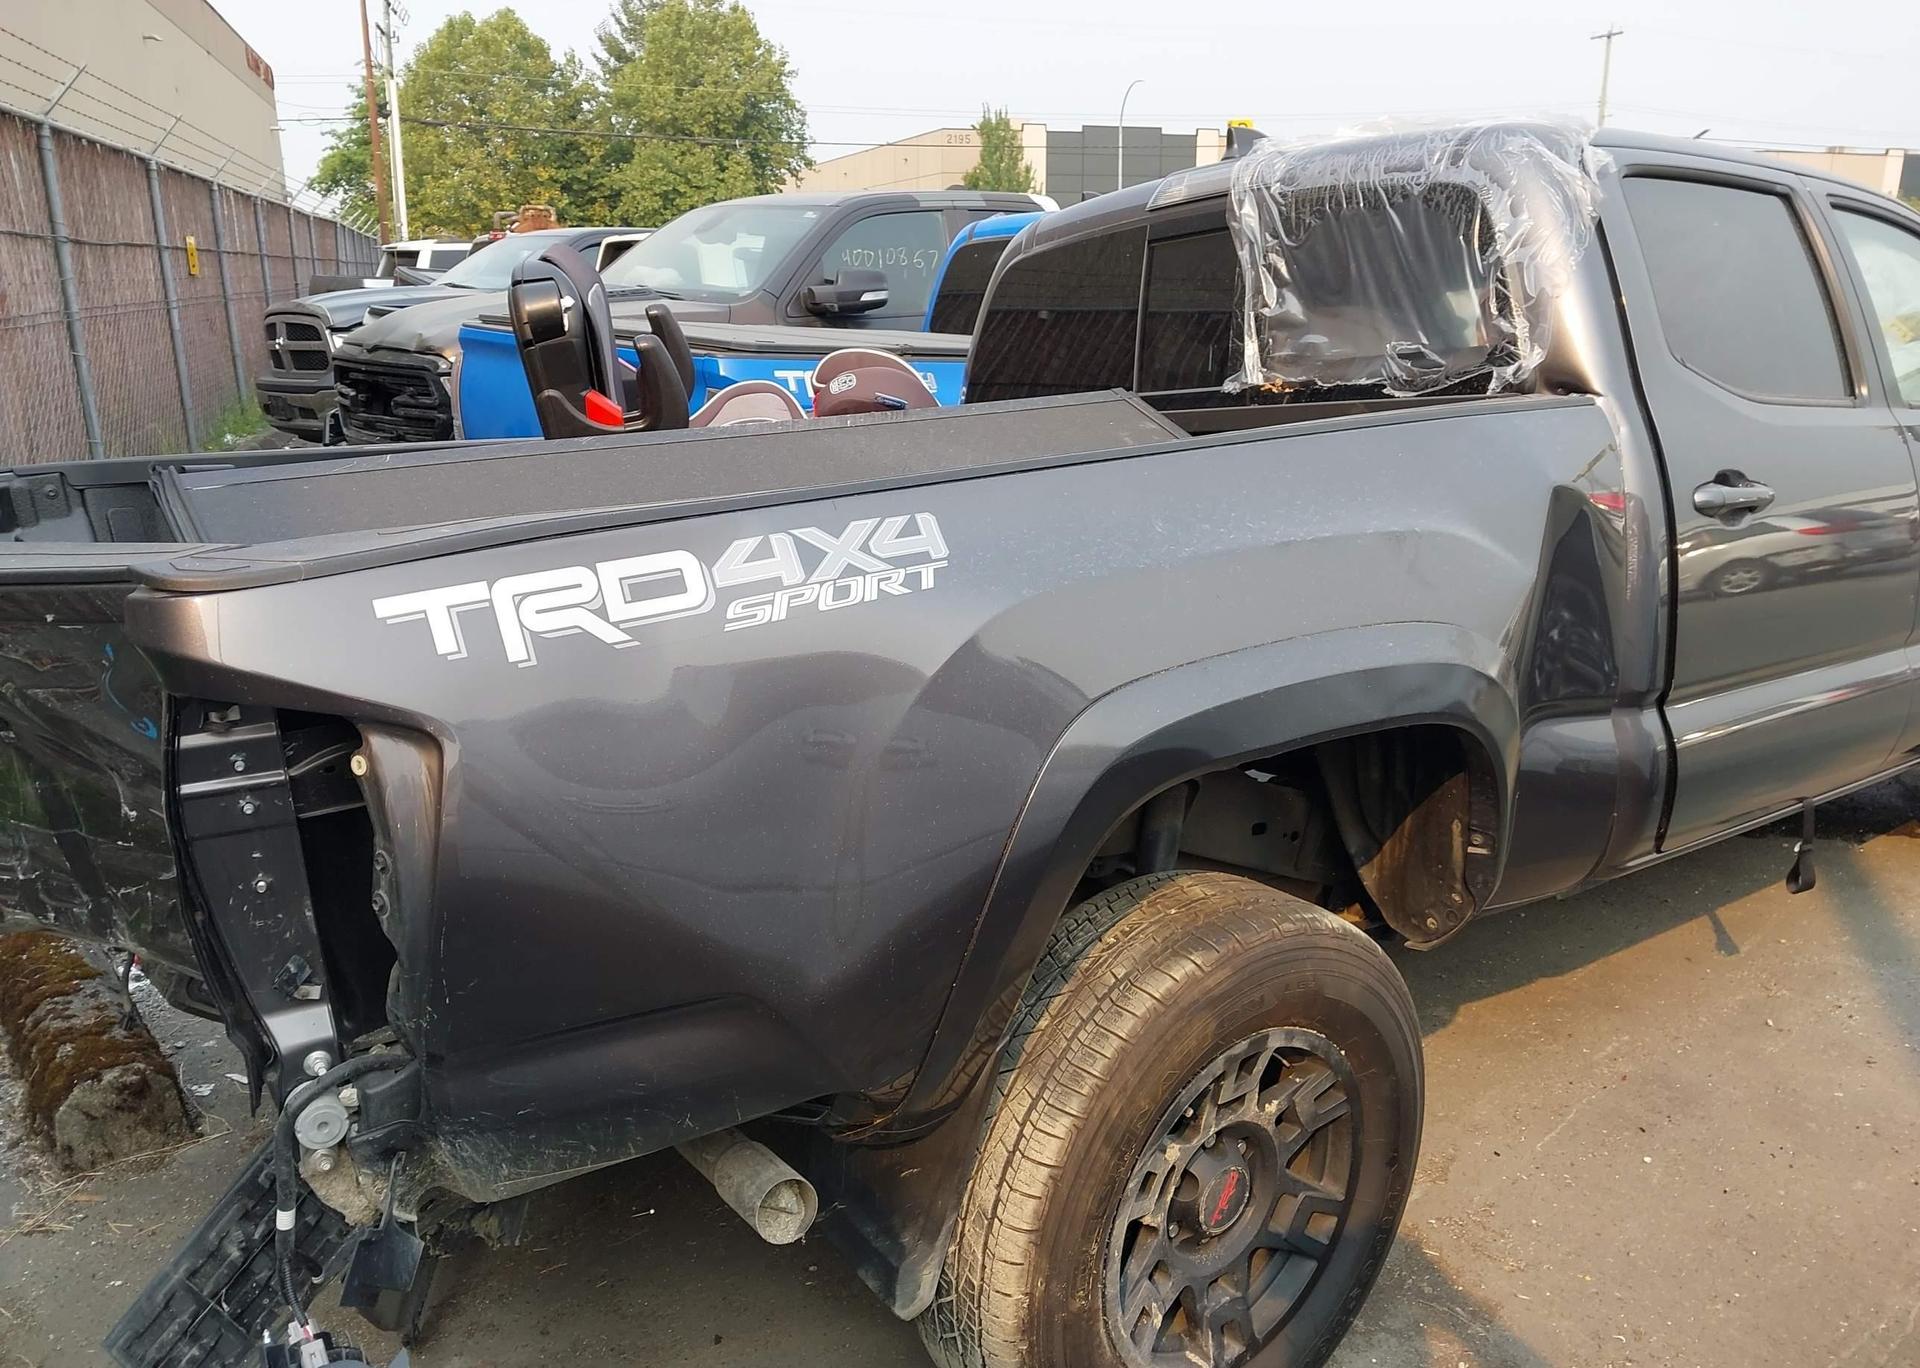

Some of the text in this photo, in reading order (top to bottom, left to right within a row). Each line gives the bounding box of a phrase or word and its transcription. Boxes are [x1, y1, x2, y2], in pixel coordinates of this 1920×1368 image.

[946, 134, 971, 144] 2195
[372, 511, 949, 668] TRD 4X4
[723, 559, 949, 632] SPORT
